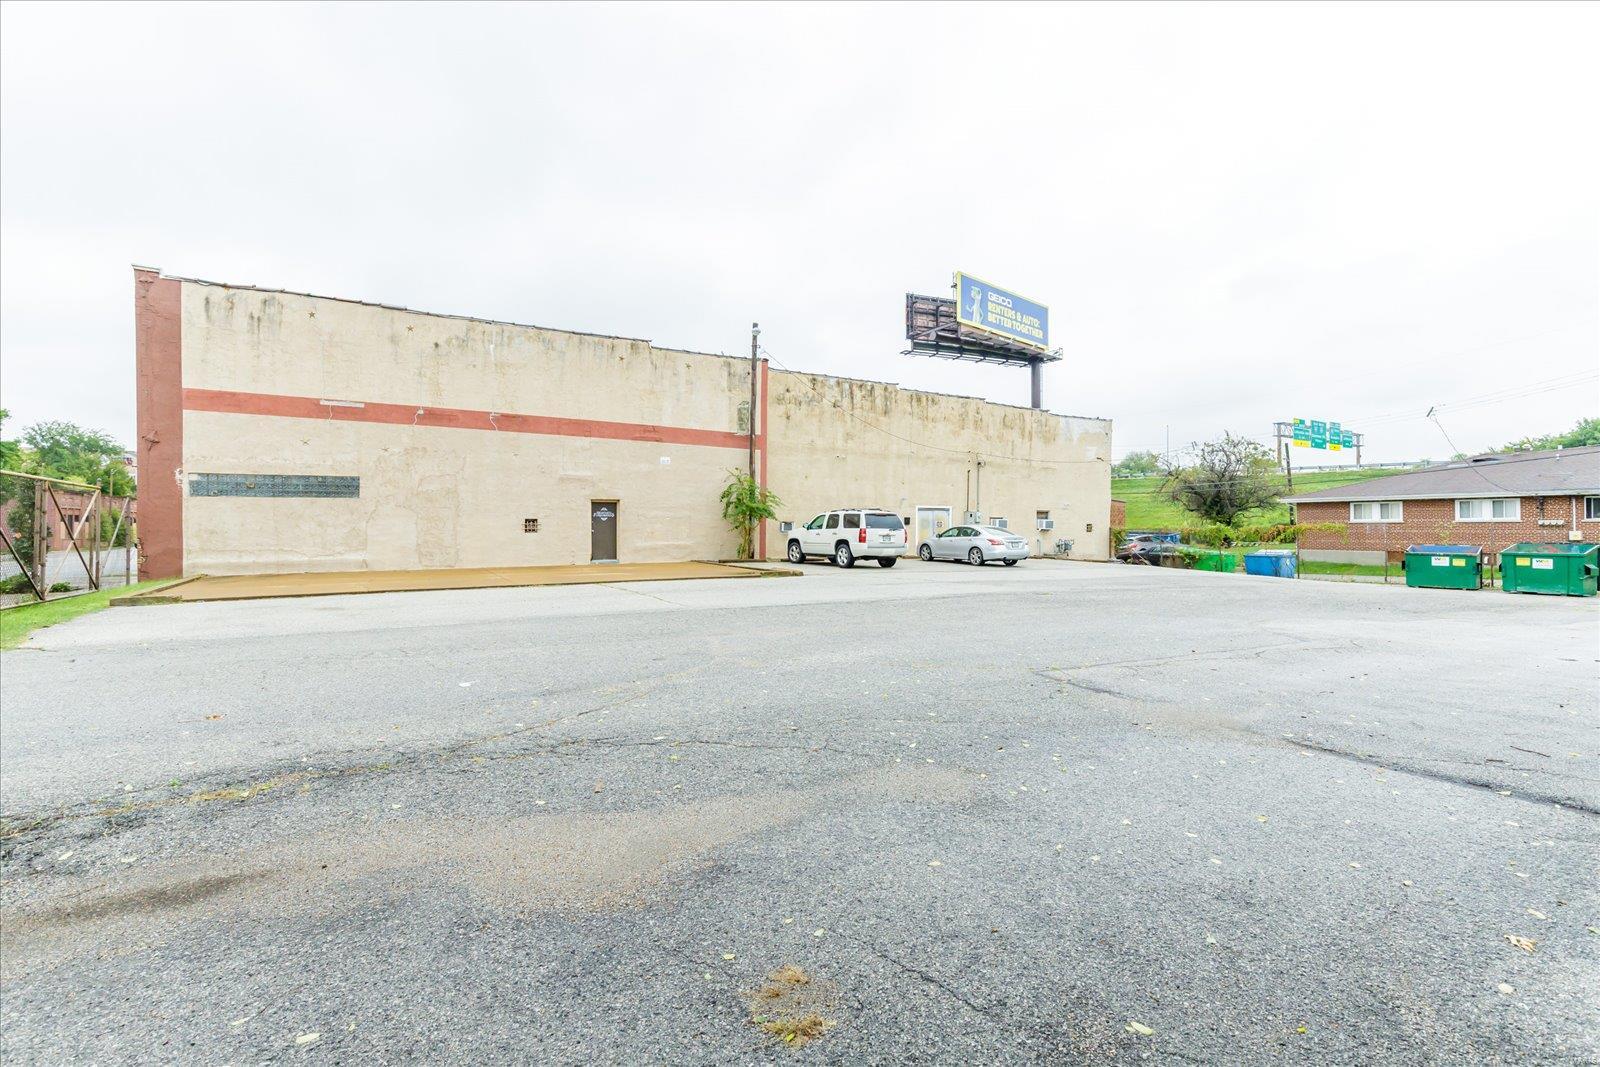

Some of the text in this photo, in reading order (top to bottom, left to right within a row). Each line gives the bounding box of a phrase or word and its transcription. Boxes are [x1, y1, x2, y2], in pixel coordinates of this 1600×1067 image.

[988, 291, 1013, 308] GEICO
[988, 301, 1016, 320] RENTERS
[988, 311, 1044, 339] BETTER TOGETHER
